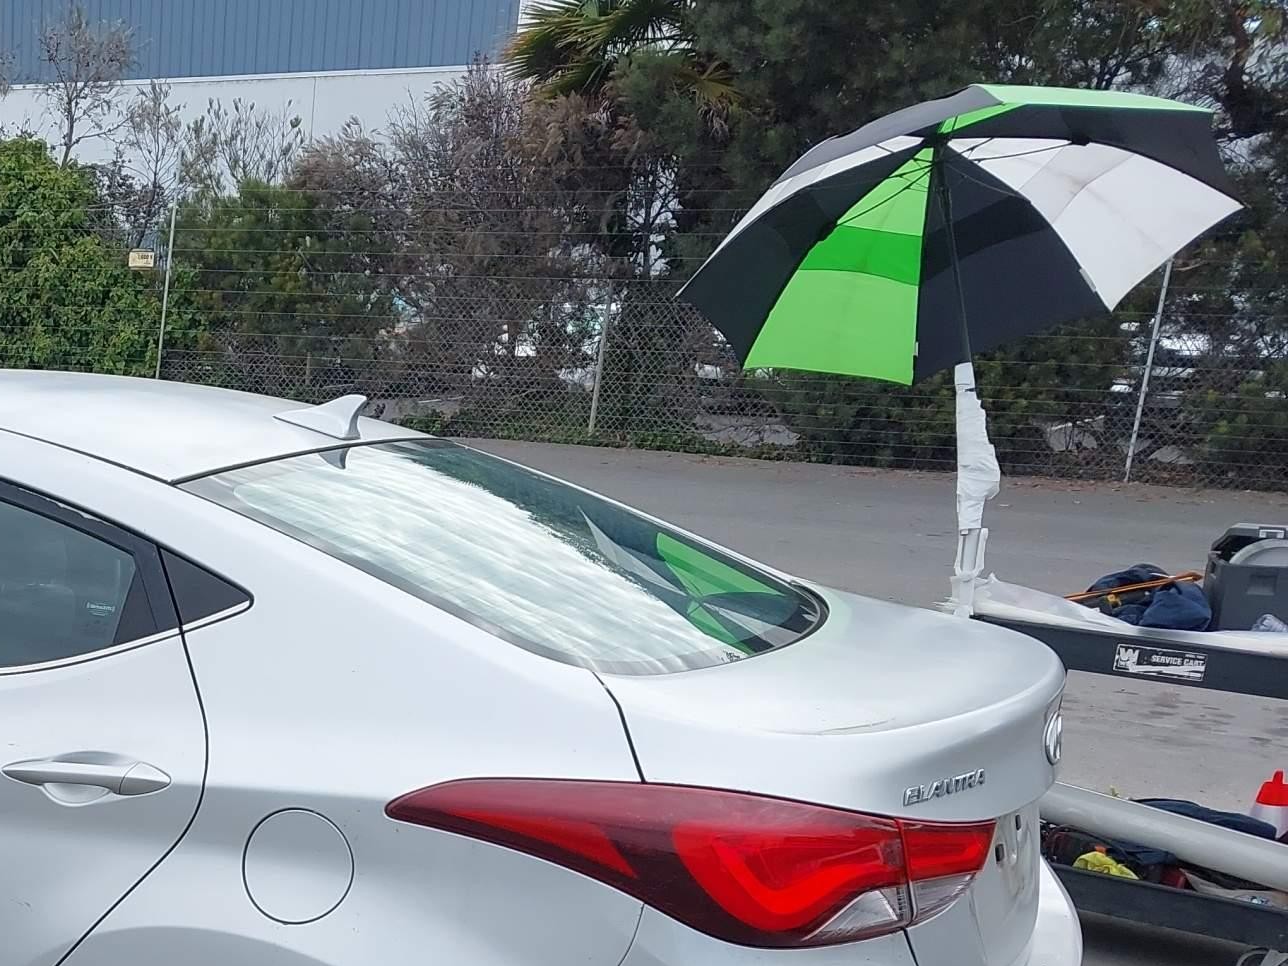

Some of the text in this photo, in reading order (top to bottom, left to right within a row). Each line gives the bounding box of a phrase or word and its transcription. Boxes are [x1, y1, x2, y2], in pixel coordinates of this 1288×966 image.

[1151, 654, 1183, 666] SERVICE
[1183, 658, 1206, 667] CART
[903, 768, 985, 807] ELANTRA
